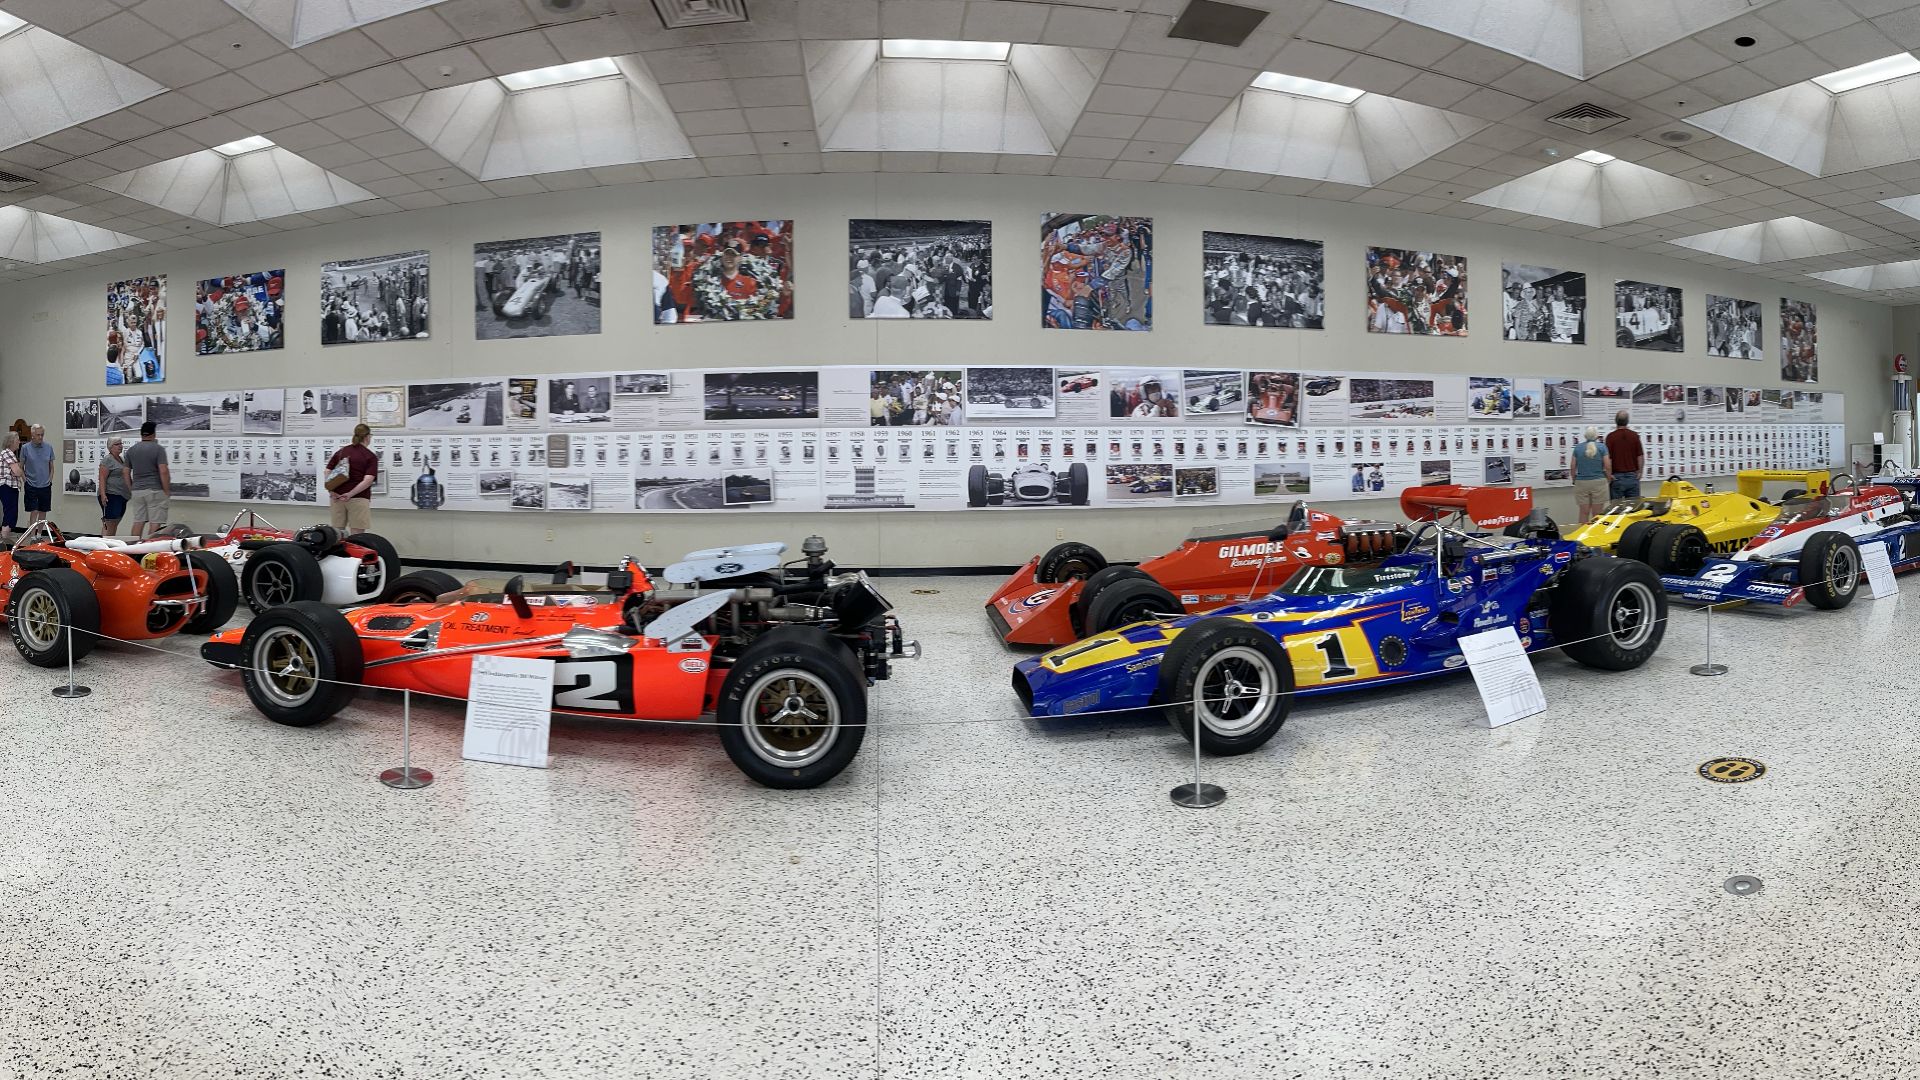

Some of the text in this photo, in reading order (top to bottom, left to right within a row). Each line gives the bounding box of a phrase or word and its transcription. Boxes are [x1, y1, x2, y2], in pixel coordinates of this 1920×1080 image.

[1513, 488, 1529, 500] 14
[1478, 515, 1520, 526] GOODYEAR
[1219, 541, 1284, 559] GILMORE
[1230, 557, 1263, 569] Racing
[1374, 572, 1411, 582] Firestone
[1700, 563, 1738, 584] 2
[1746, 584, 1792, 595] CITICORP
[461, 622, 510, 634] TREATMENT
[1048, 637, 1123, 669] 1
[1316, 631, 1357, 681] 1
[554, 660, 621, 710] 2
